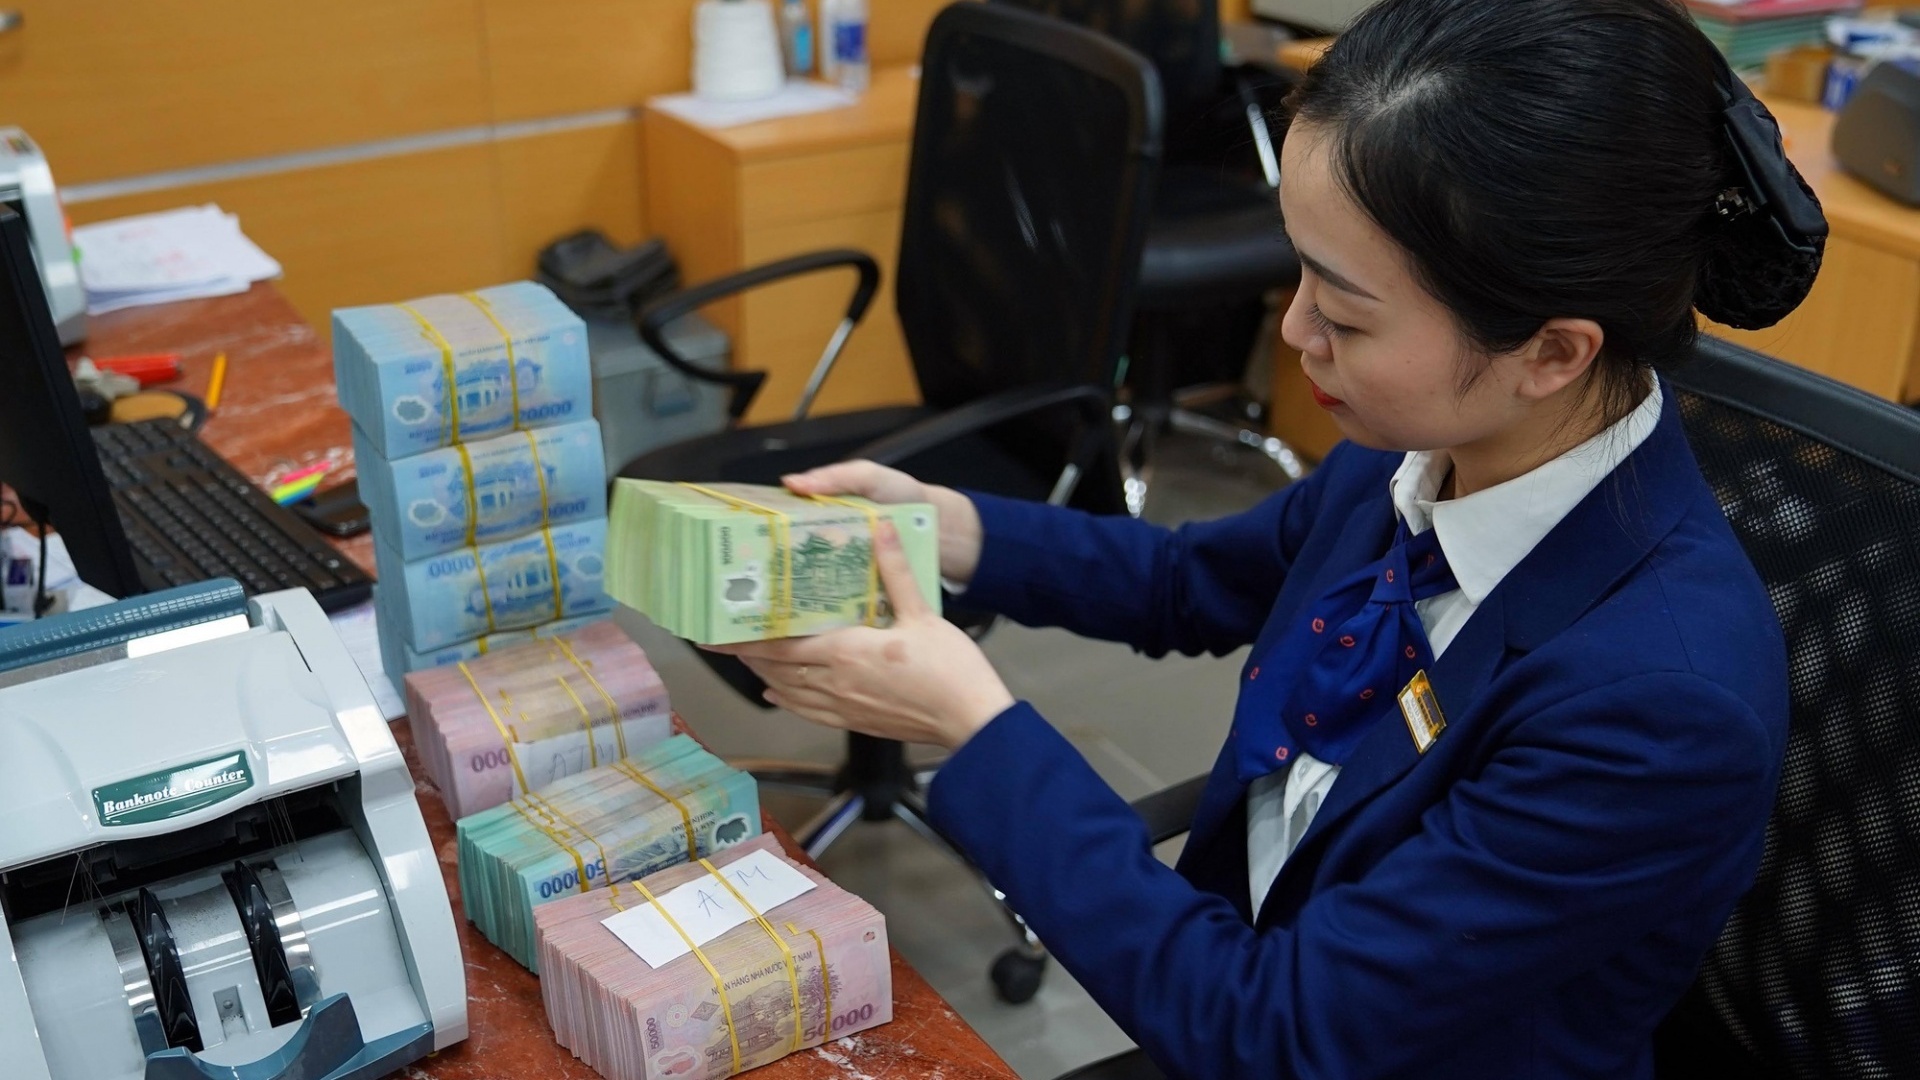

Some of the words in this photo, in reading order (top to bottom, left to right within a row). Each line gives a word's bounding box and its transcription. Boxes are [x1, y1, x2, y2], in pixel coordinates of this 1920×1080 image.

[103, 785, 177, 814] Banknote
[184, 768, 245, 792] Counter
[697, 865, 774, 918] AM
[782, 954, 797, 968] VT
[797, 950, 813, 963] NAM
[803, 1003, 874, 1042] 50000
